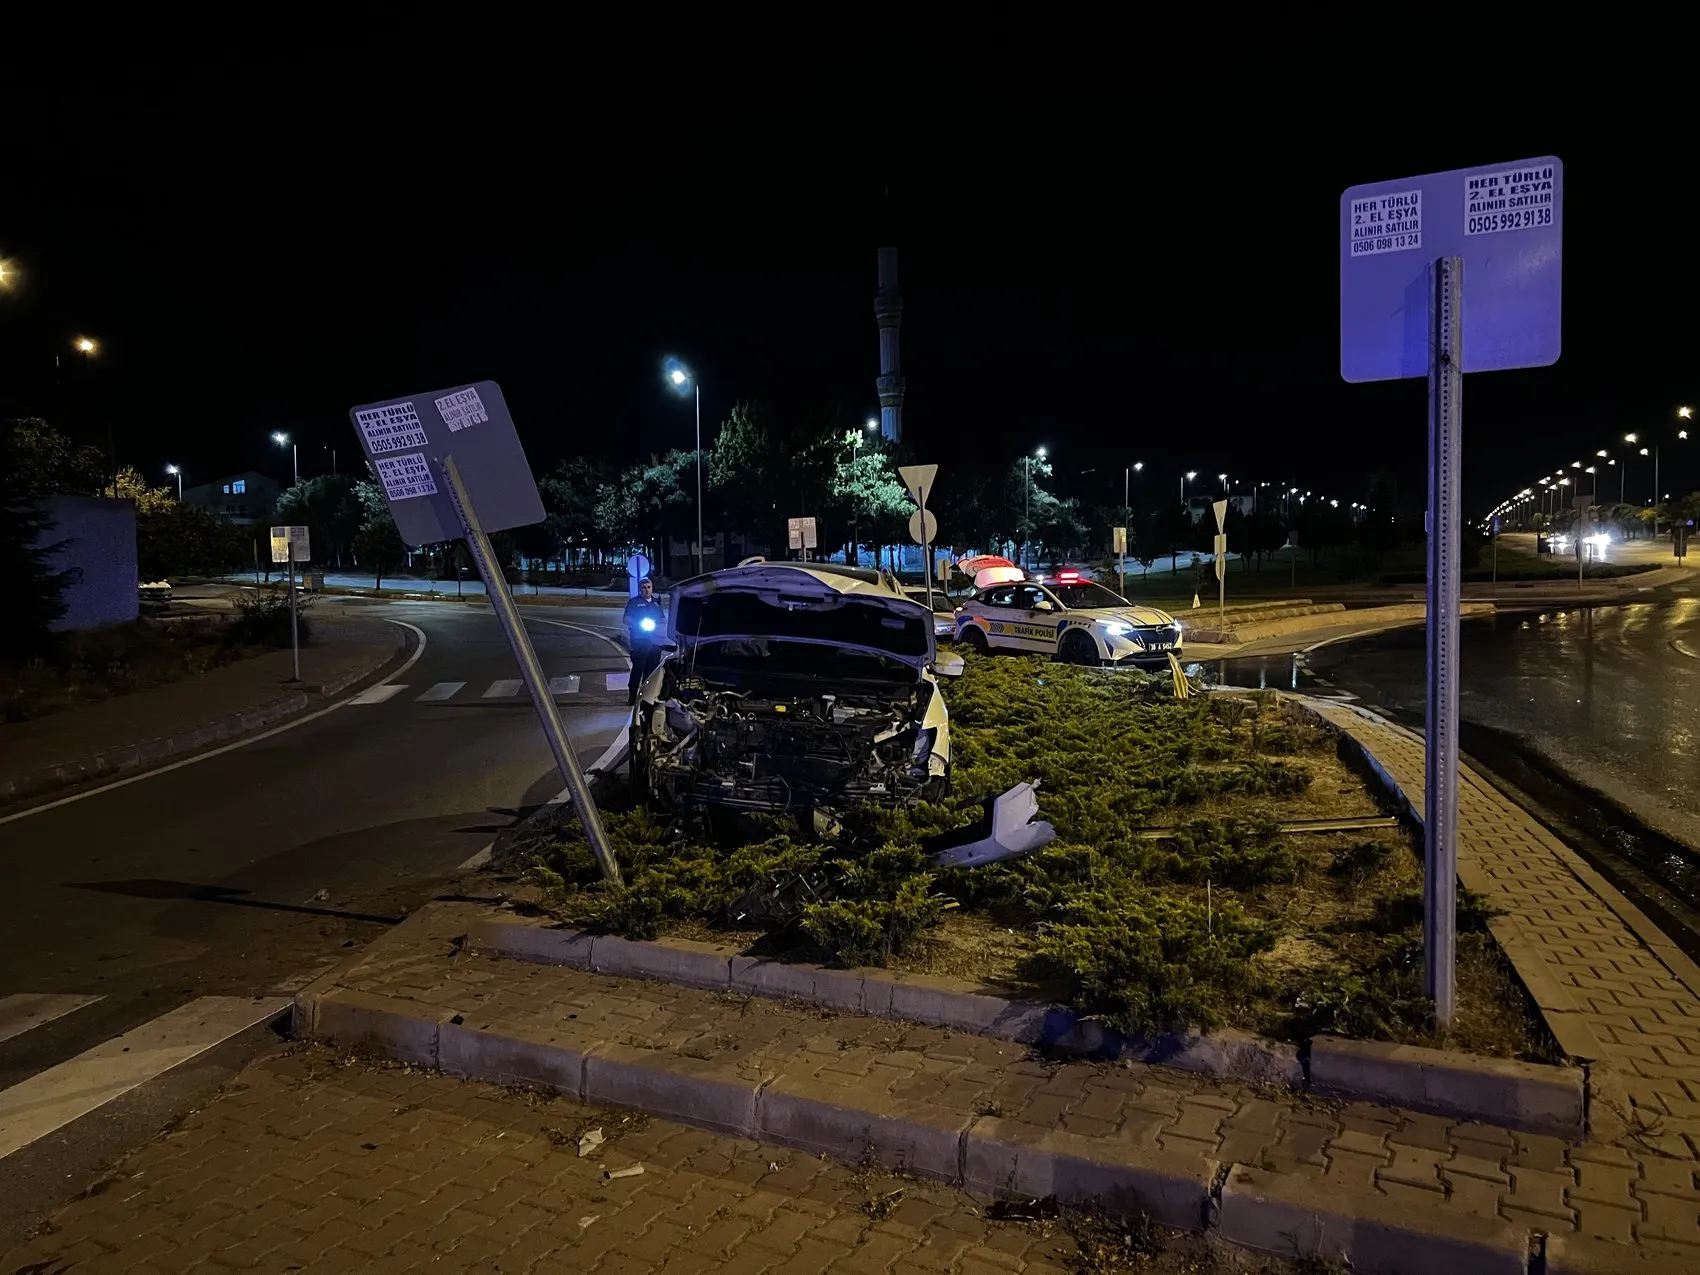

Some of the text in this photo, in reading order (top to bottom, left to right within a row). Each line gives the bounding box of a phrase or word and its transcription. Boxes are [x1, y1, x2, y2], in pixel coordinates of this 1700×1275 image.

[1469, 167, 1553, 190] HER TÜRLÜ
[1488, 187, 1506, 198] EL
[1510, 181, 1552, 194] EŞYA
[1354, 193, 1418, 214] HER TÜRLÜ
[1469, 193, 1551, 213] ALINIR SATILIR
[1355, 206, 1418, 225] 2. EL EŞYA
[1469, 208, 1551, 233] 0505 992 91 38
[1354, 219, 1419, 238] ALINIR SATILIR
[1353, 233, 1419, 253] 0506 098 13 24
[359, 404, 414, 421] HER TÜRLÜ
[375, 419, 388, 427] EL
[389, 413, 418, 424] EŞYA
[367, 421, 421, 438] ALINIR SATILIR
[371, 438, 393, 452] 0505
[391, 435, 408, 448] 992
[378, 454, 423, 470] HER TÜRLÜ
[392, 469, 403, 477] EL
[404, 464, 426, 475] EŞYA
